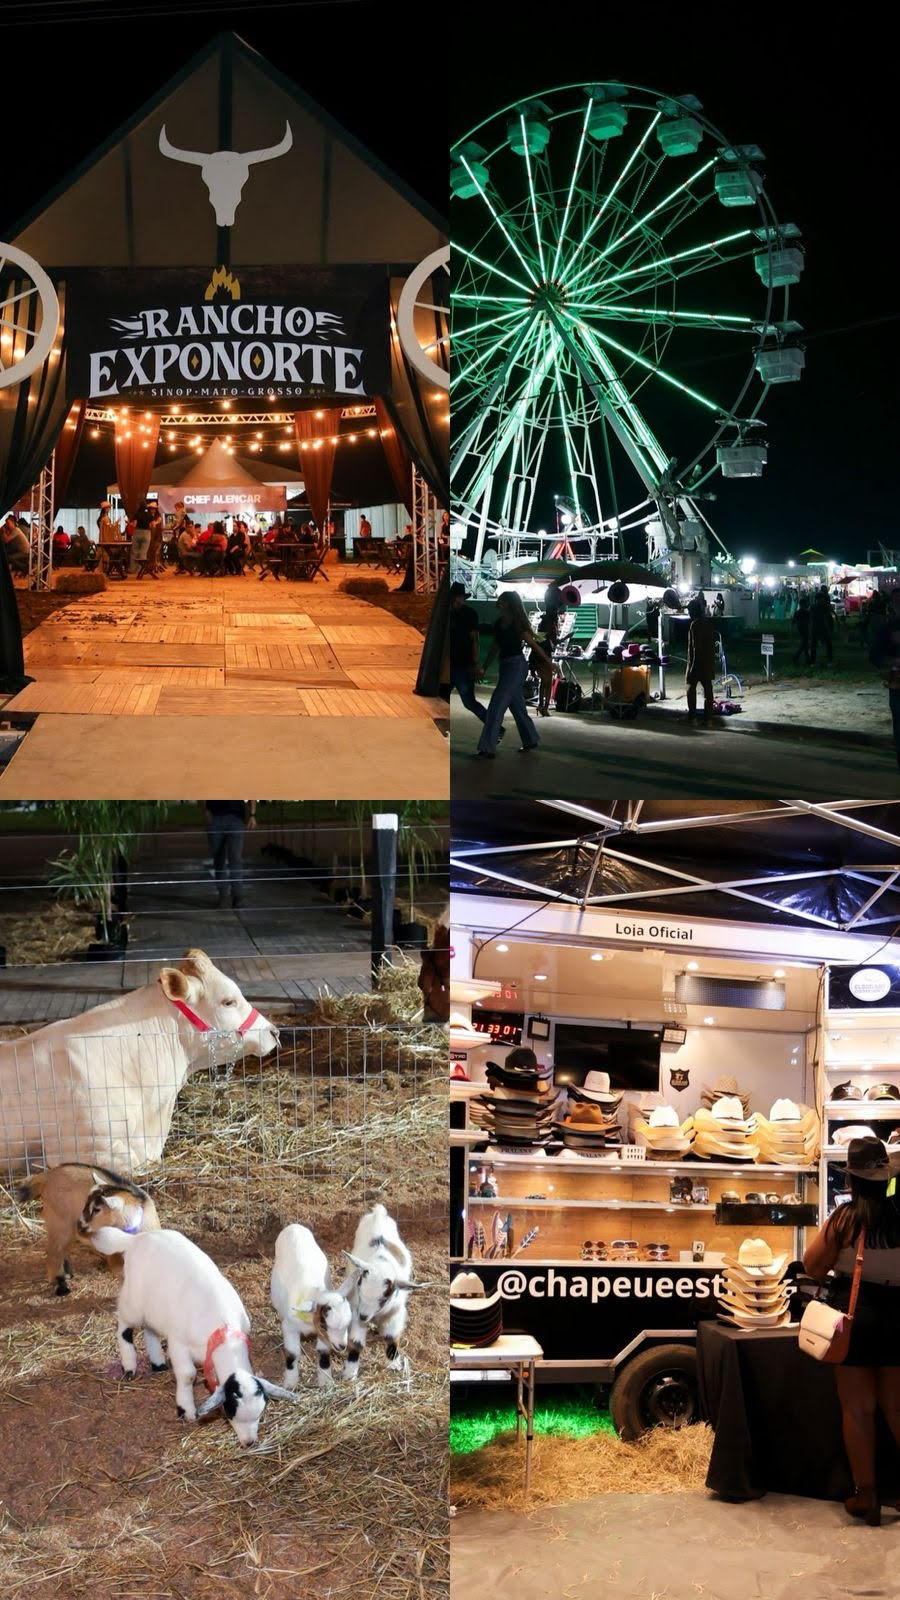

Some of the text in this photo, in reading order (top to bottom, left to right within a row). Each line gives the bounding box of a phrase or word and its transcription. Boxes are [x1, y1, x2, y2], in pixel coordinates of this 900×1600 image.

[138, 304, 315, 339] RANCHO
[88, 341, 367, 399] EXPONORTE
[183, 494, 261, 504] CHEF ALENCAR
[615, 923, 693, 940] Loja Oficial
